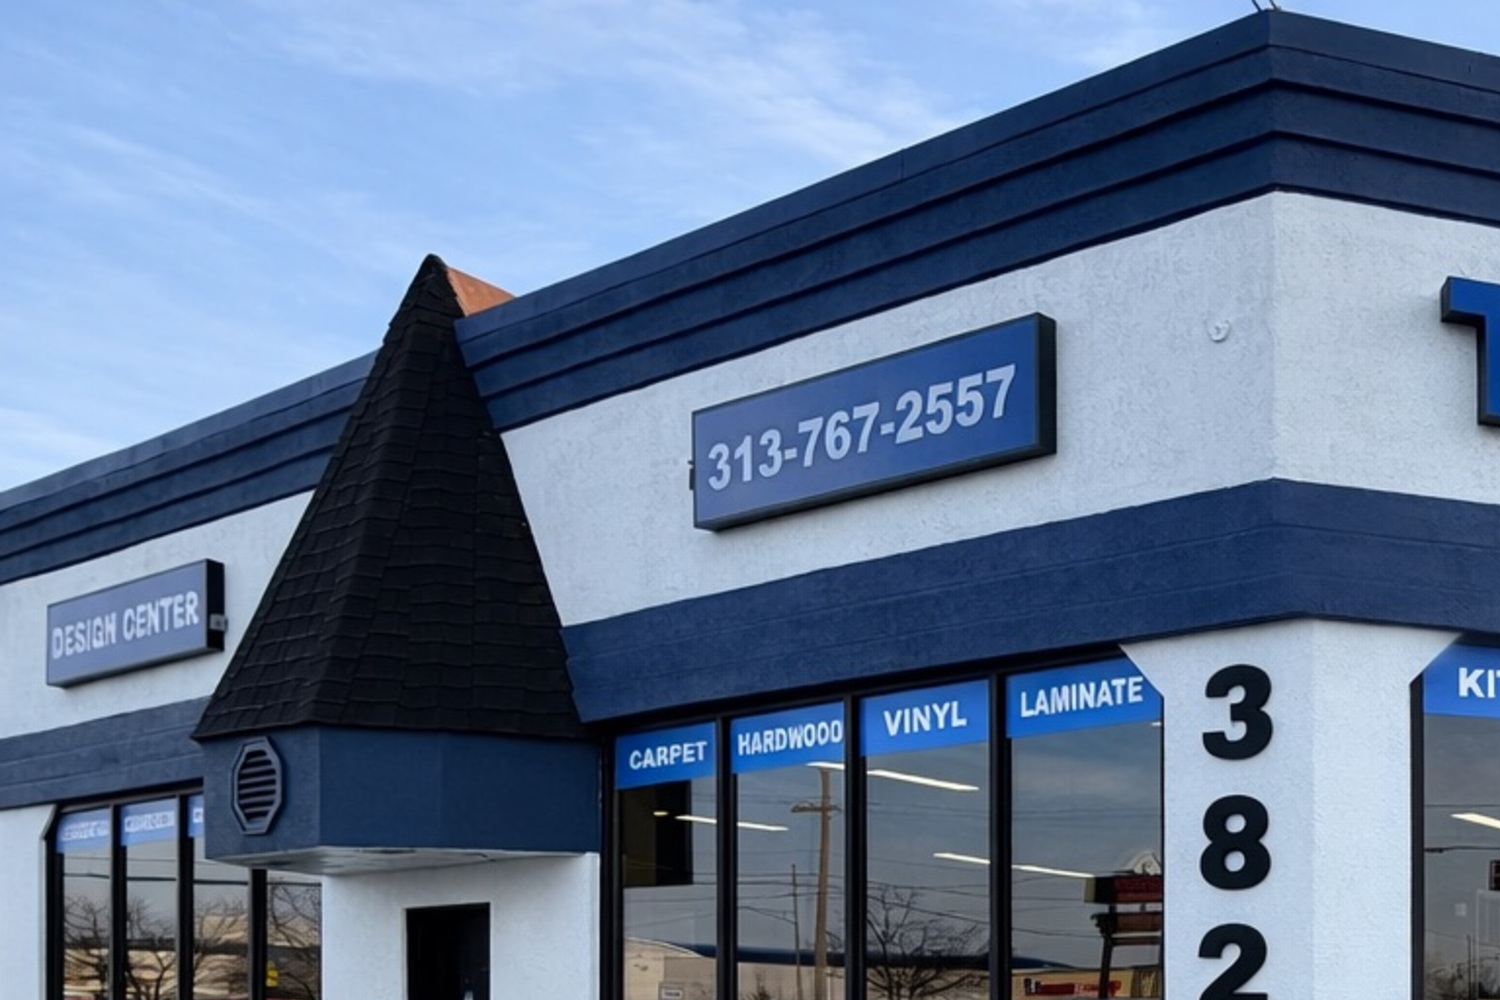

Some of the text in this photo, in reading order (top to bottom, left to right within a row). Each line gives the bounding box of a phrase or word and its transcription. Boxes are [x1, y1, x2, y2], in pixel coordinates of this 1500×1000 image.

[707, 364, 1017, 491] 313-767-2557
[52, 591, 199, 660] DESIGN CENTER
[1019, 676, 1144, 718] LAMINATE
[737, 719, 843, 756] HARDWOOD
[883, 701, 968, 737] VINYL
[628, 740, 708, 770] CARPET
